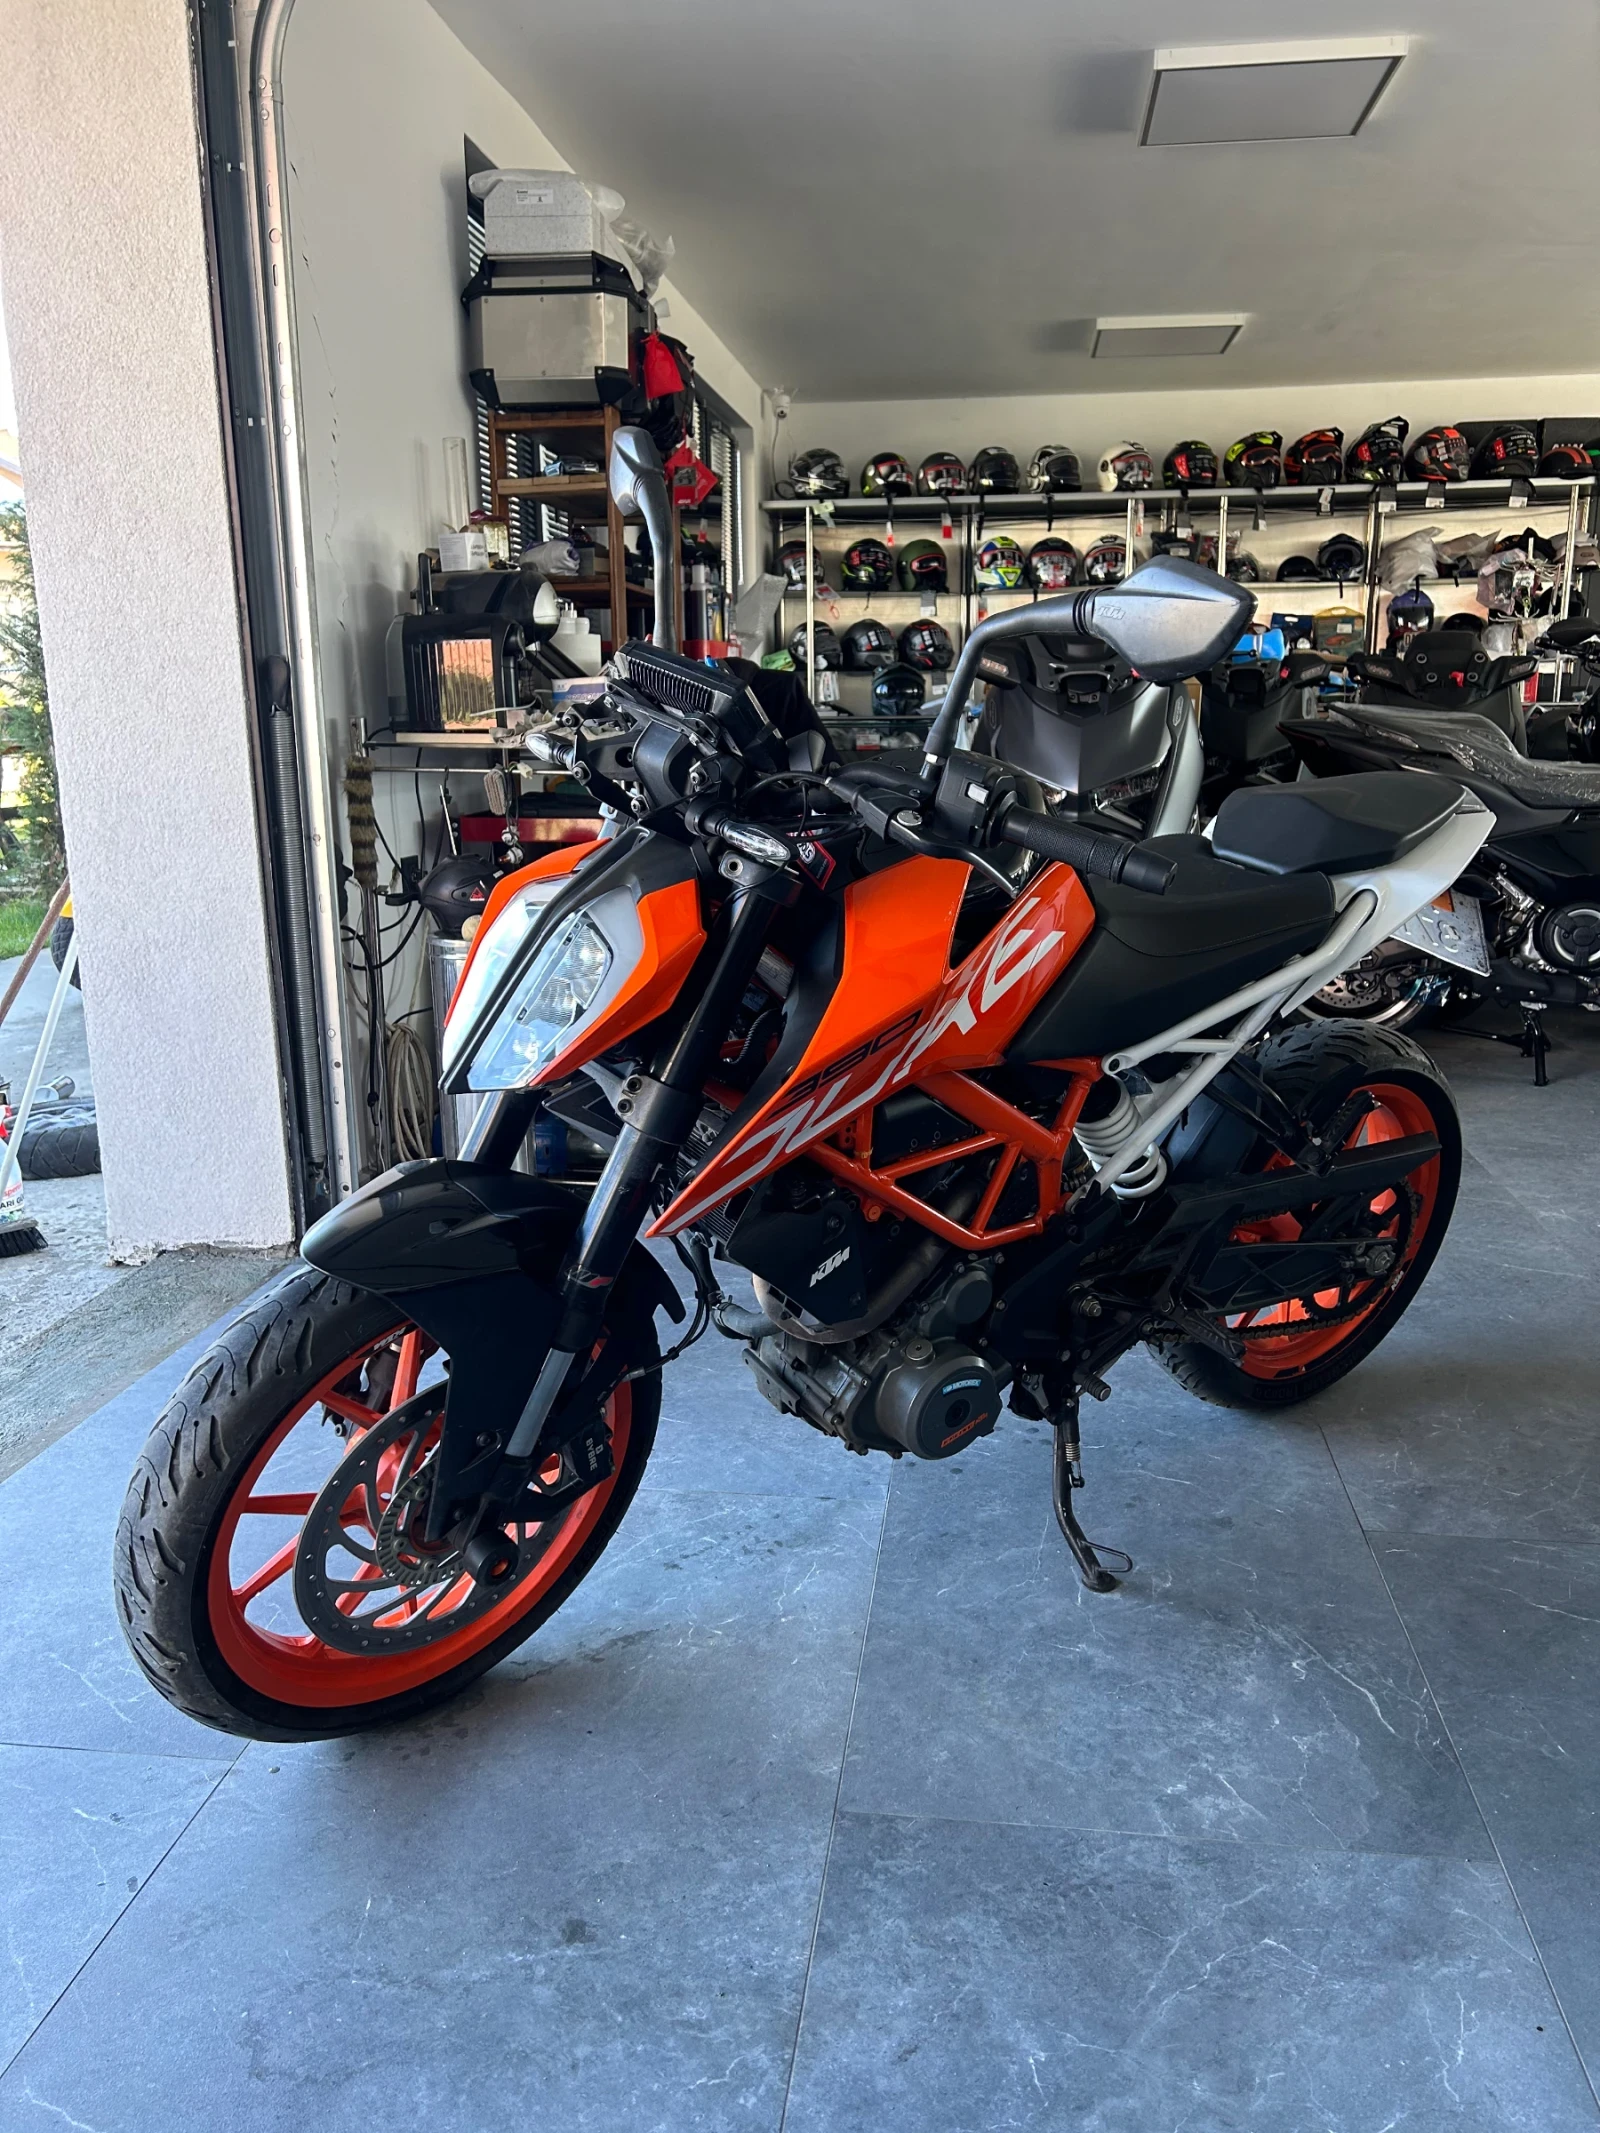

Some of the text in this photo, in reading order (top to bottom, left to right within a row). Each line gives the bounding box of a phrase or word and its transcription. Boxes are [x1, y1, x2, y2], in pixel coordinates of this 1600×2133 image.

[1098, 605, 1126, 621] KTM
[664, 897, 1066, 1235] DUKE
[766, 1008, 922, 1121] 390
[809, 1246, 850, 1288] KTM
[585, 1437, 598, 1471] BYBRE
